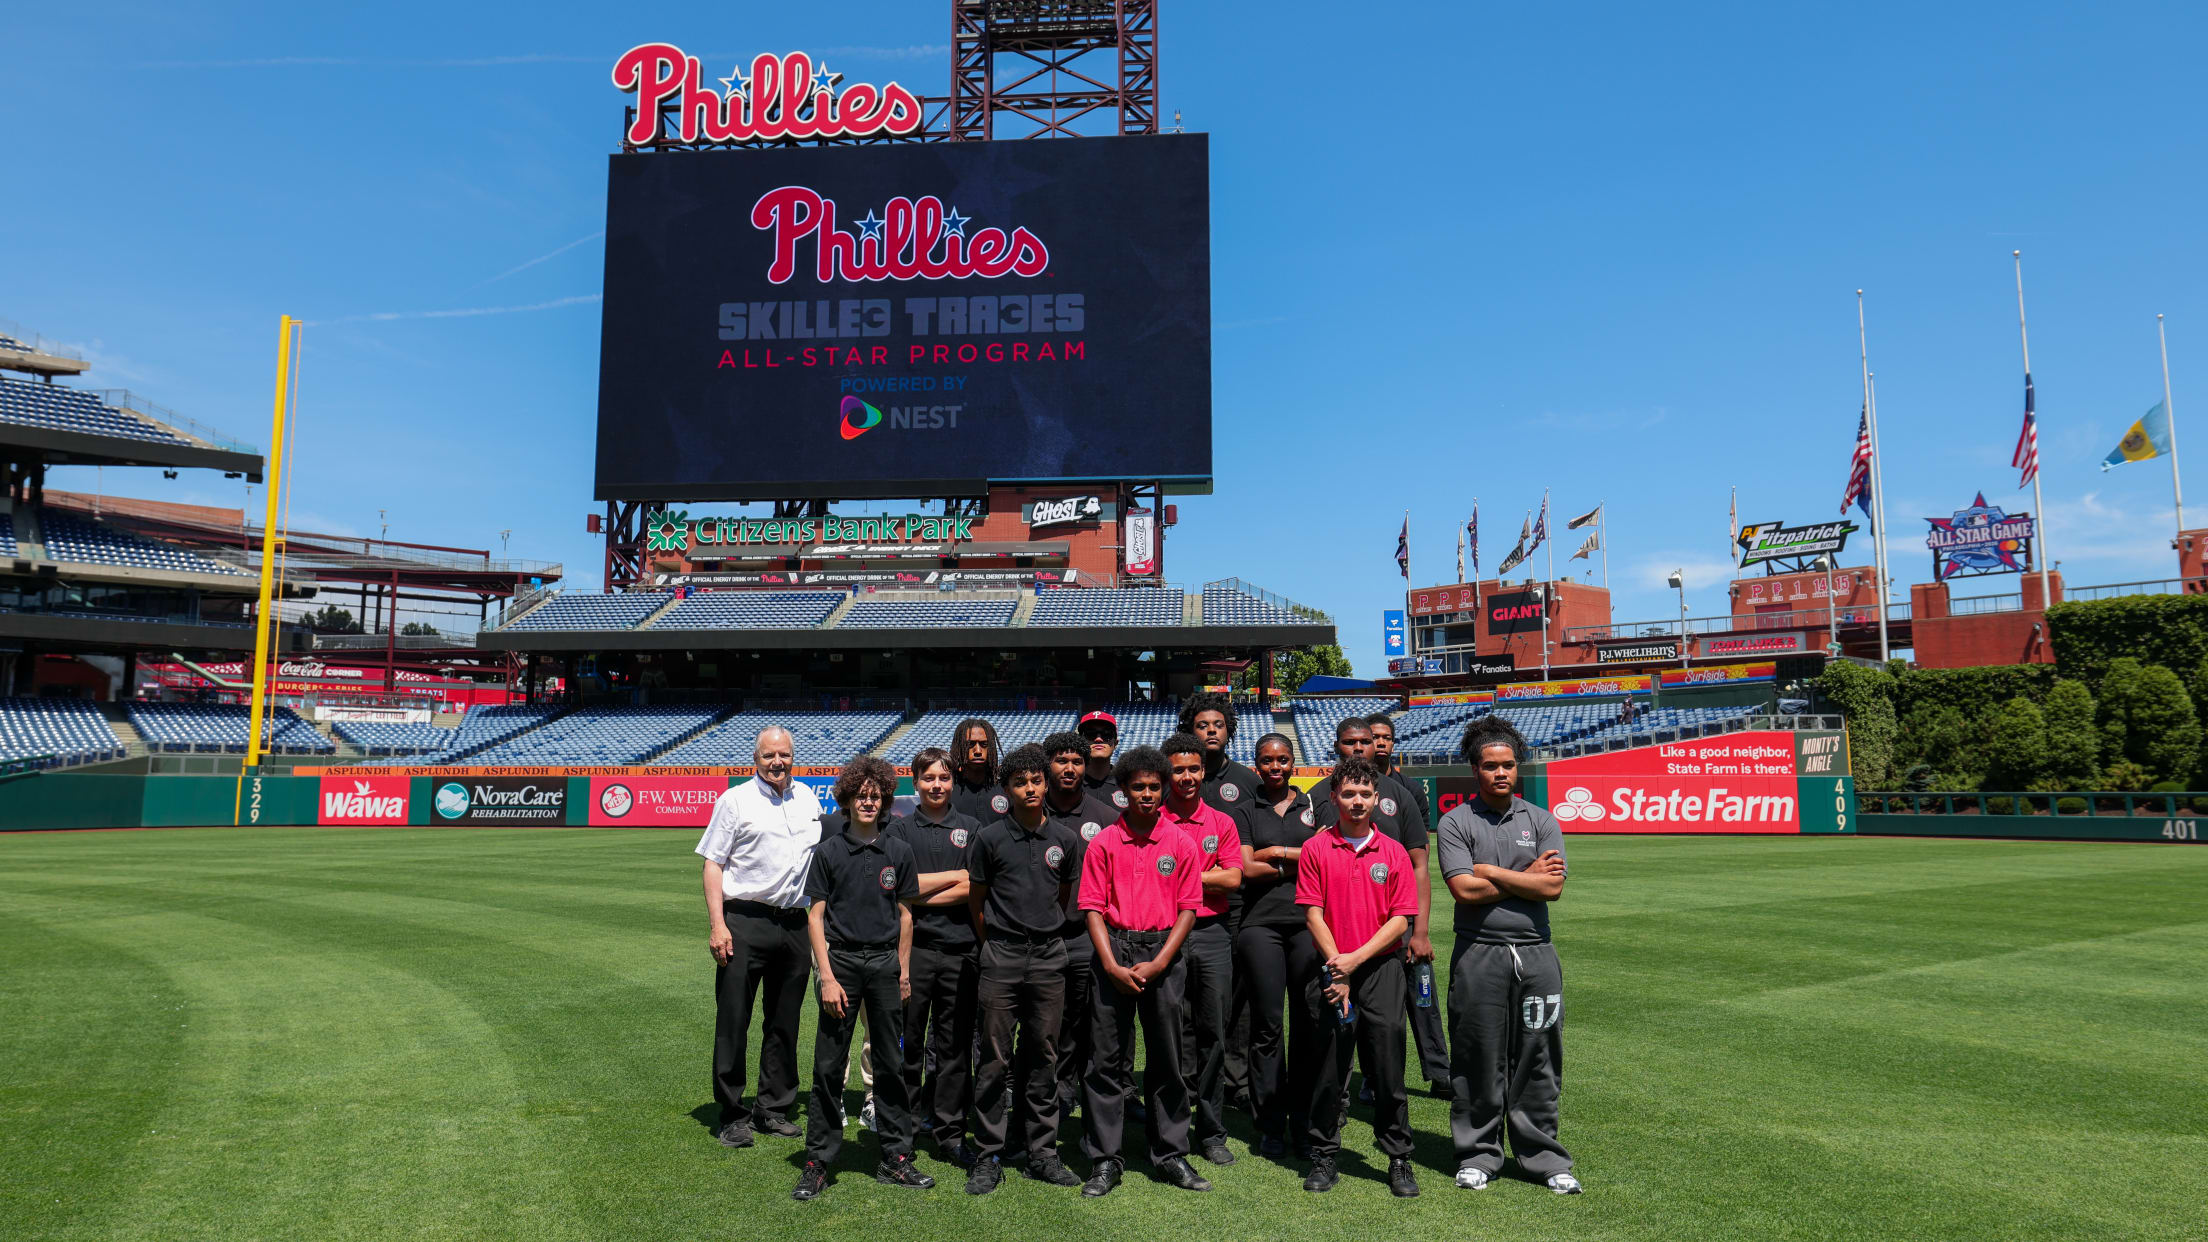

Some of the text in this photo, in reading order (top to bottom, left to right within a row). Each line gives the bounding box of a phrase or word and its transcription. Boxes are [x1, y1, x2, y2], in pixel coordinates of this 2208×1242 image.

[612, 42, 923, 147] Phillies
[751, 186, 1049, 284] Phillies
[717, 341, 1086, 368] ALL-STAR PROGRAM
[840, 376, 967, 394] POWERED BY
[890, 405, 962, 430] NEST
[1032, 496, 1088, 528] GHOST
[695, 510, 973, 543] Citizens Bank Park
[1992, 522, 2032, 540] GAME
[1747, 523, 1843, 550] Fitzpatrick
[761, 574, 784, 583] Phillies
[896, 573, 920, 581] Phillies
[1035, 572, 1059, 580] Phillies
[1835, 575, 1849, 590] 15
[1492, 604, 1542, 621] GIANT
[1710, 636, 1796, 649] TONY LUKE'S
[279, 660, 363, 678] Coca-Cola CORNER
[1482, 664, 1512, 675] Fanatics
[1685, 669, 1725, 684] Surfside
[1505, 685, 1542, 699] Surfside
[1578, 681, 1618, 695] Surfside
[1660, 746, 1791, 760] Like a good neighbor,
[1802, 736, 1840, 755] MONTY'S
[325, 767, 391, 775] ASPLUNDH
[403, 767, 469, 775] ASPLUNDH
[483, 767, 549, 775] ASPLUNDH
[1667, 763, 1700, 775] State
[1706, 763, 1737, 774] Farm
[1741, 763, 1750, 774] is
[1805, 754, 1833, 773] ANGLE
[563, 767, 629, 776] ASPLUNDH
[643, 767, 710, 776] ASPLUNDH
[471, 785, 563, 806] NovaCare
[638, 791, 718, 804] F.W. WEBB
[325, 791, 402, 818] Wawa
[656, 806, 700, 814] COMPANY
[1611, 787, 1793, 822] State Farm
[471, 809, 558, 818] REHABILITATION
[2162, 820, 2198, 840] 401
[1523, 994, 1560, 1029] 07
